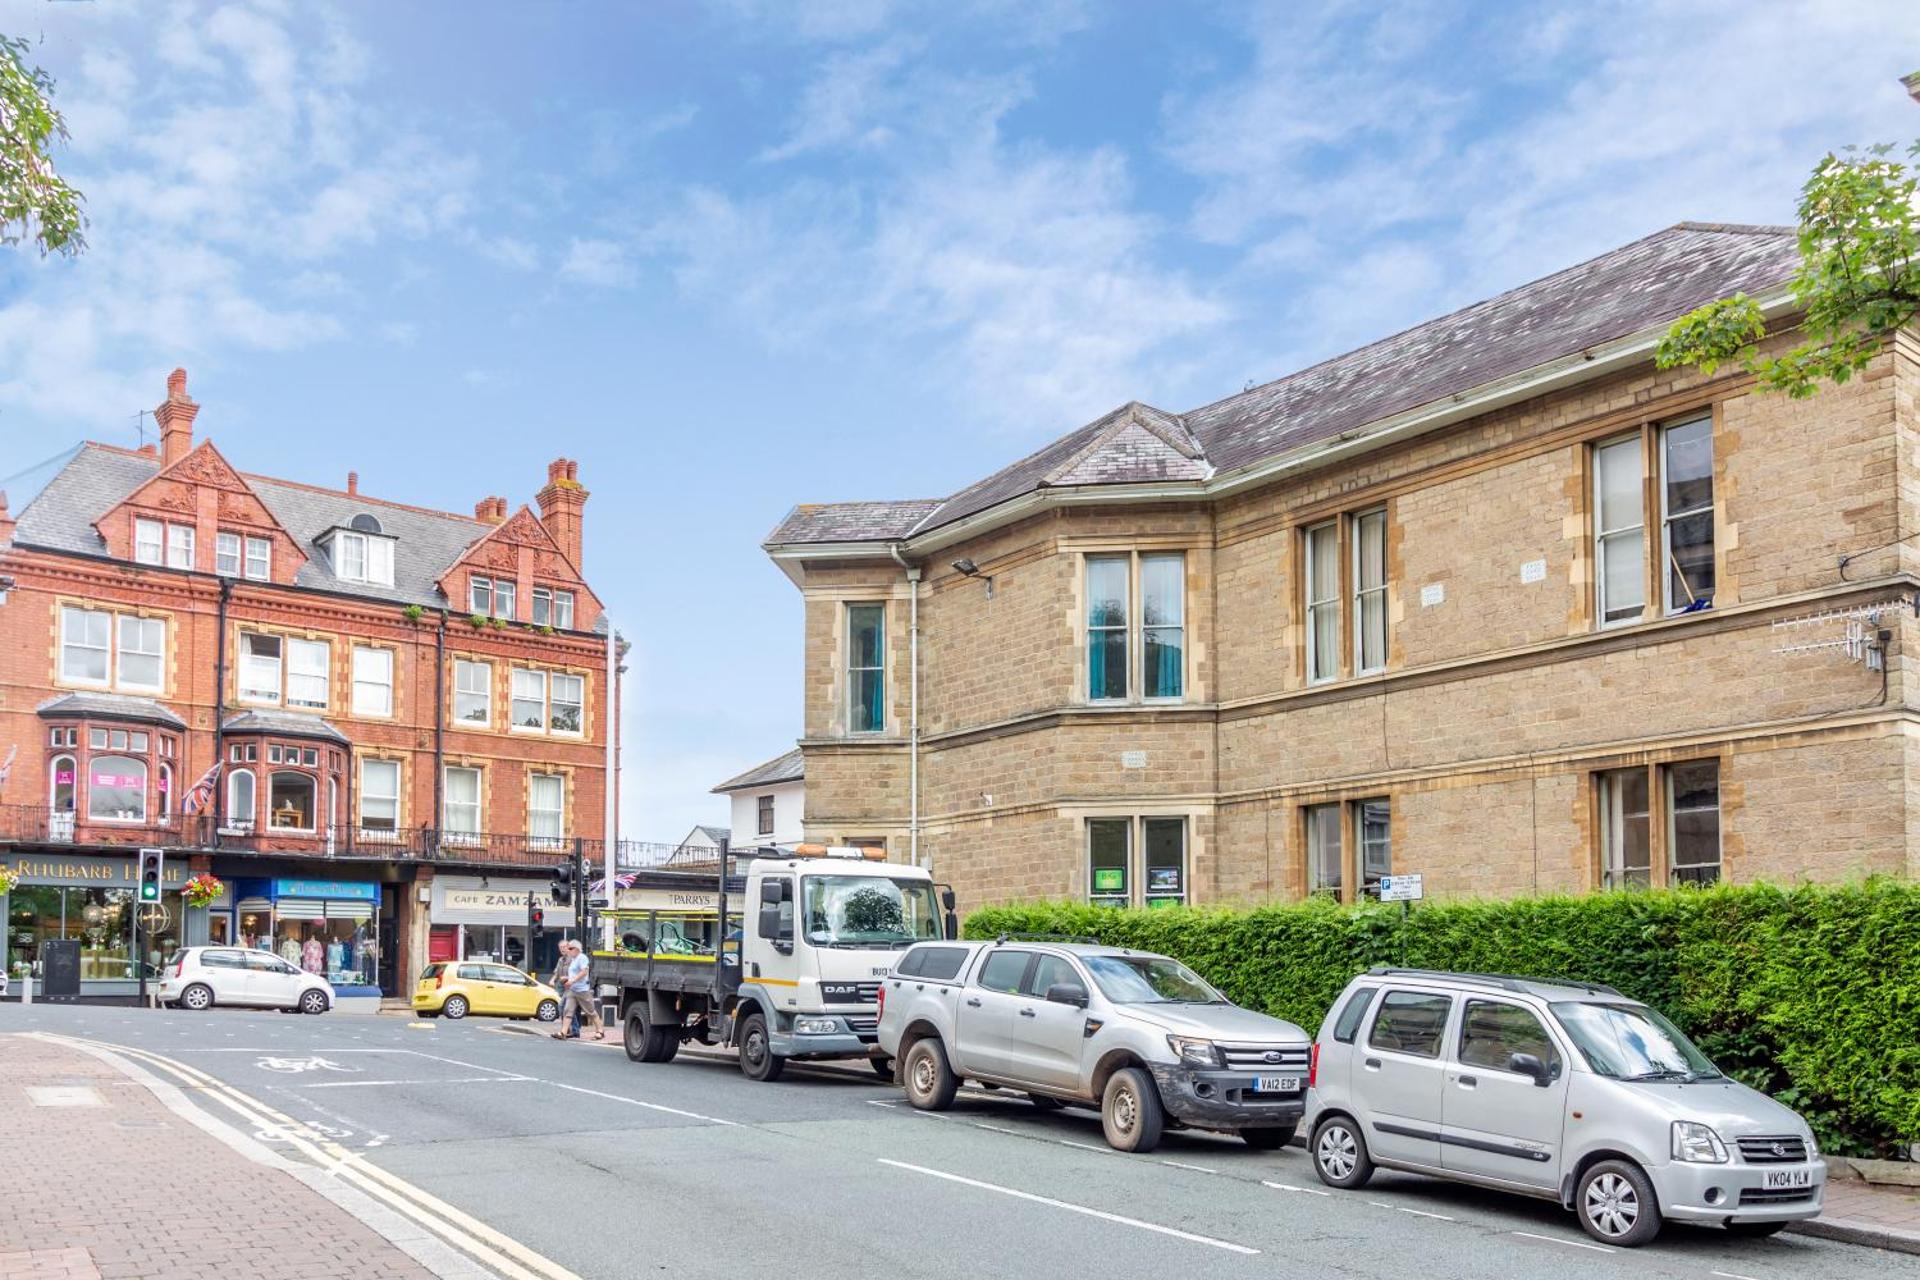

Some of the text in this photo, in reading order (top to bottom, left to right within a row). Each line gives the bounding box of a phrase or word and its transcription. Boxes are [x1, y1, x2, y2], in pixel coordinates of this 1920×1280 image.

[18, 859, 113, 880] RHUBARB
[1261, 1078, 1280, 1090] VA12
[1768, 1171, 1791, 1186] VK04
